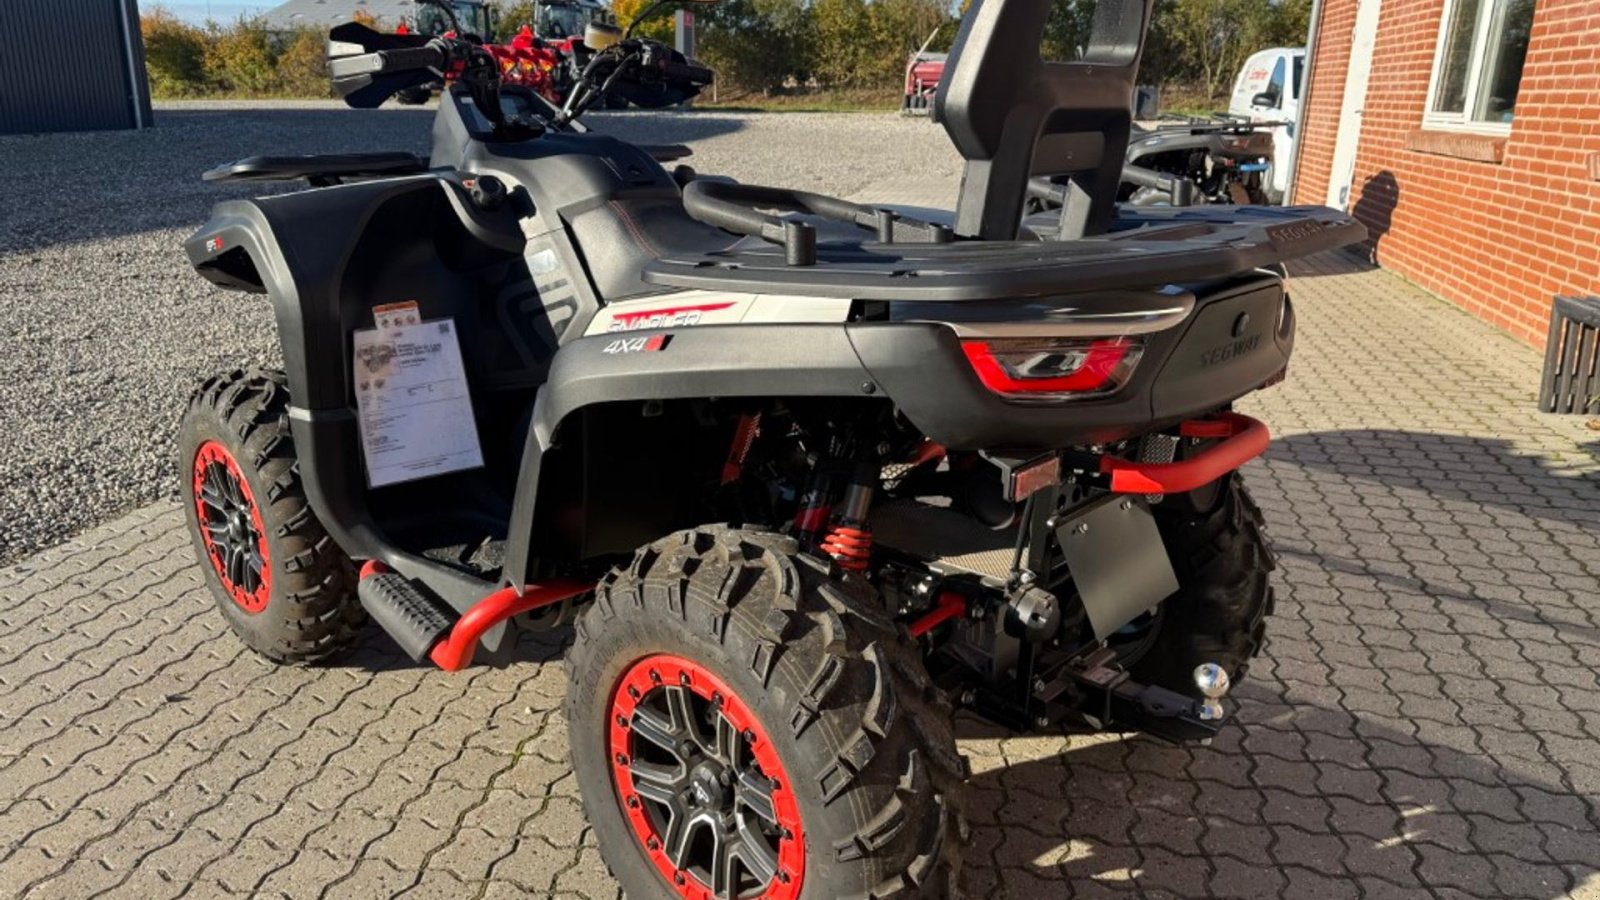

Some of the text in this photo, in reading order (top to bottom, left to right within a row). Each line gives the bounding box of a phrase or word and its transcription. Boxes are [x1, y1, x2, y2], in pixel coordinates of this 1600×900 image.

[1272, 222, 1323, 241] SEGWAY
[603, 337, 648, 353] 4X4
[1201, 335, 1262, 366] SEGWAY
